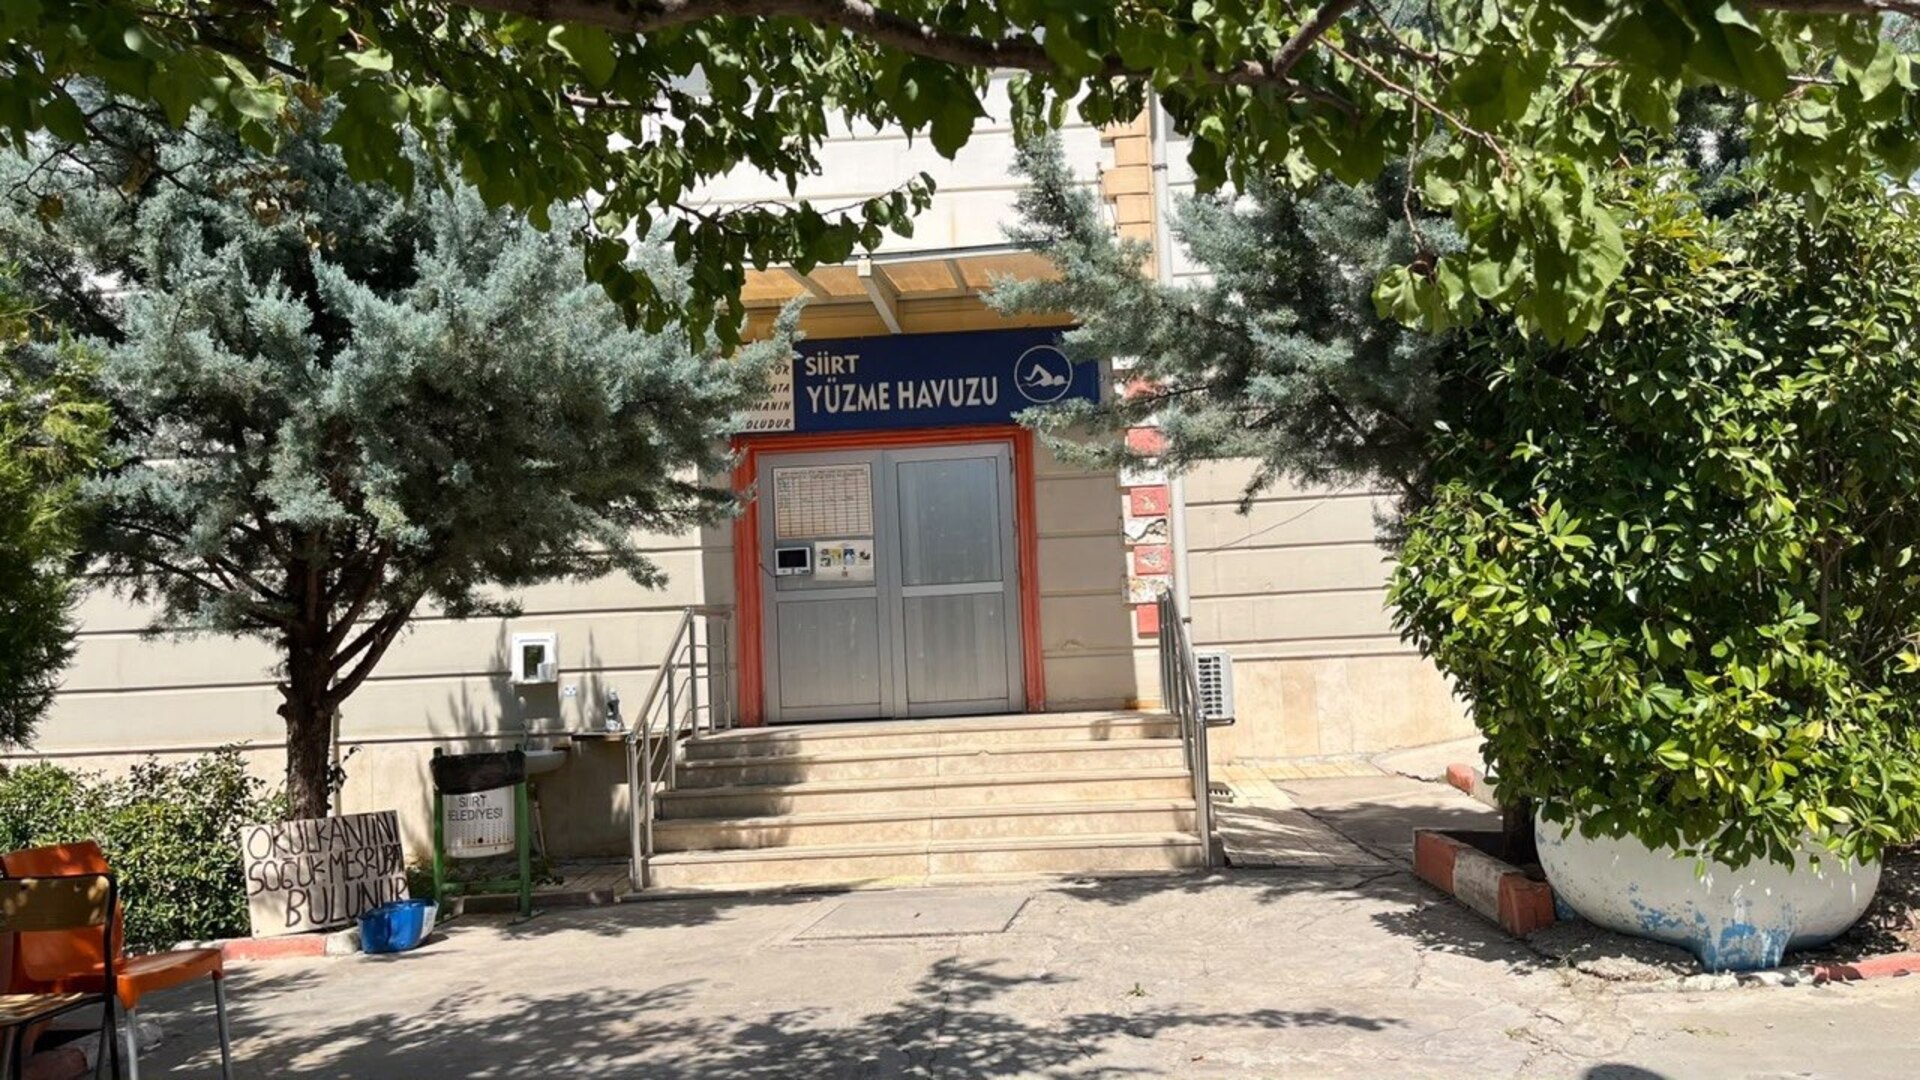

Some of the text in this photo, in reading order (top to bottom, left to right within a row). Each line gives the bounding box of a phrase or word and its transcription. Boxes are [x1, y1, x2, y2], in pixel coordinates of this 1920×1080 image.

[805, 351, 860, 377] SİİRT
[806, 376, 999, 414] YÜZME HAVUZU
[744, 419, 791, 430] OLUDUR
